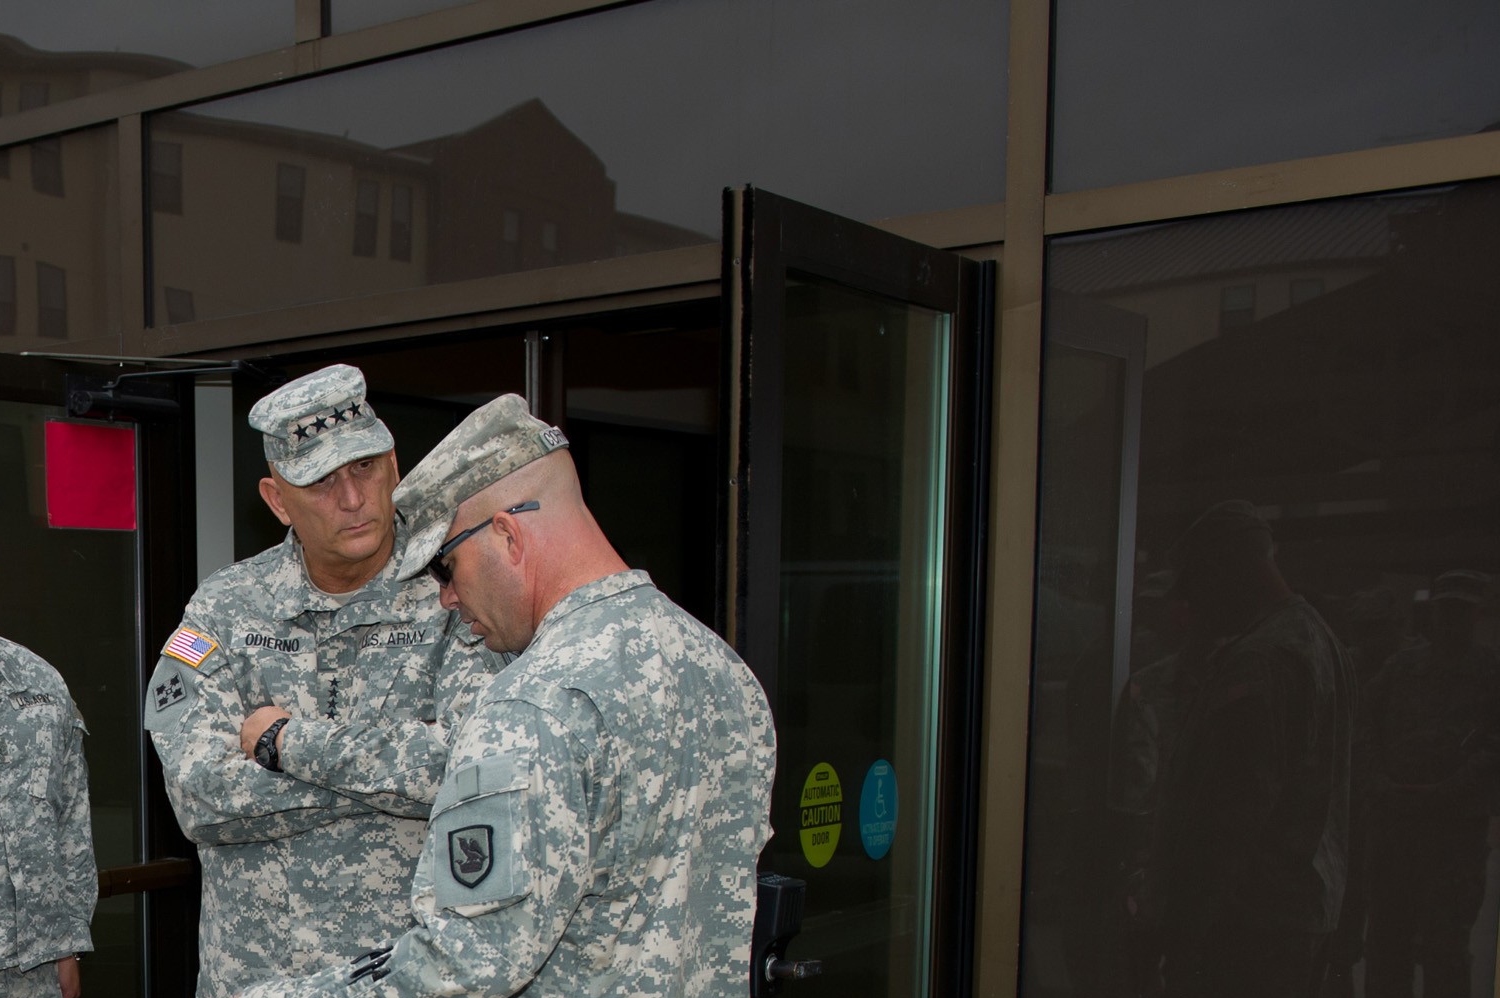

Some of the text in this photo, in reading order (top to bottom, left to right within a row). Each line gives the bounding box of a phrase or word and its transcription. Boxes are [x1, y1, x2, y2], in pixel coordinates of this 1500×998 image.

[245, 633, 300, 652] ODIERNO
[362, 630, 426, 648] U.S. ARMY
[803, 784, 840, 801] AUTOMATIC
[801, 804, 841, 827] CAUTION
[811, 831, 830, 846] DOOR
